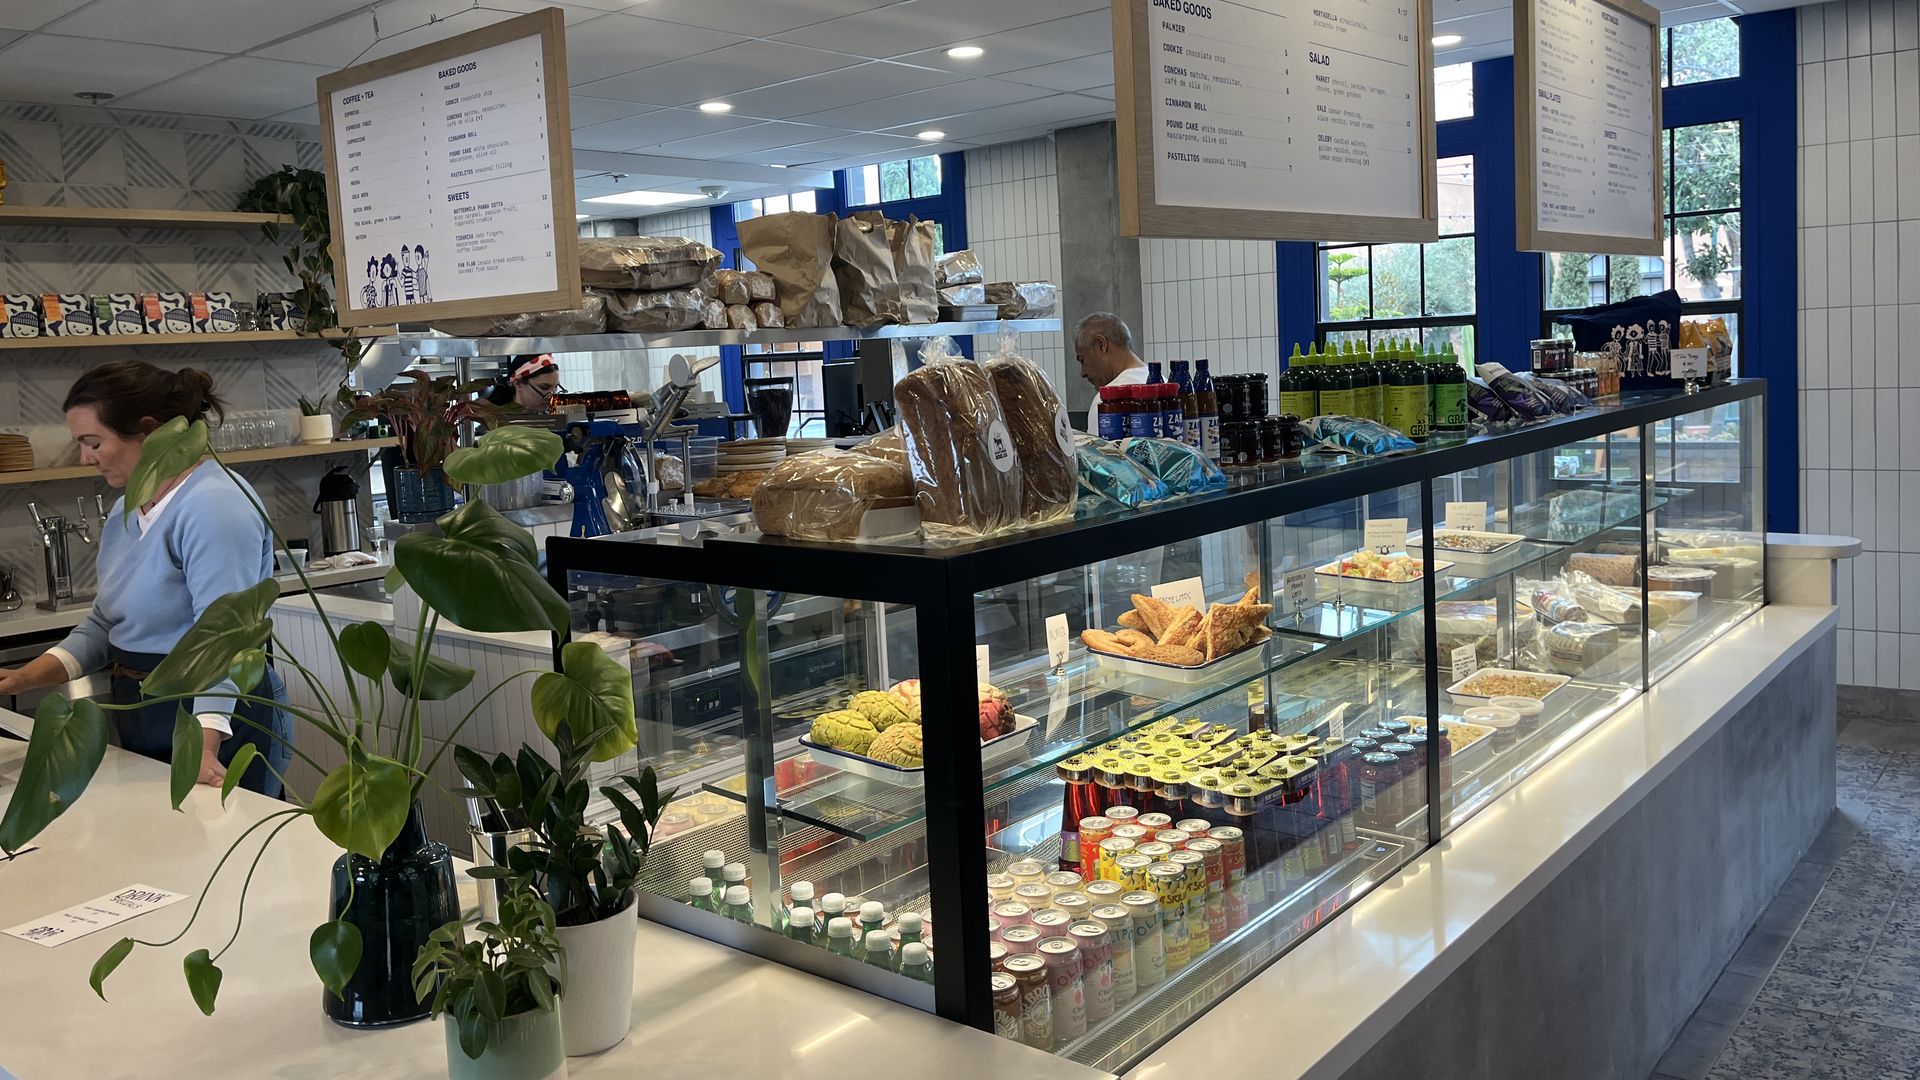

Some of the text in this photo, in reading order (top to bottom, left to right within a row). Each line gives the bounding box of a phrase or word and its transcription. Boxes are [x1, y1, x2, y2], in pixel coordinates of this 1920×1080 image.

[1182, 3, 1212, 20] GOODS
[1314, 9, 1338, 22] MORTADELLA
[1162, 21, 1186, 33] PALMIER
[1162, 43, 1184, 54] COOKIE
[1186, 50, 1212, 60] chocolate
[1214, 56, 1226, 64] chip
[1309, 52, 1330, 66] SALAD
[438, 62, 477, 79] BAKED GOODS
[1164, 65, 1188, 77] CONCHAS
[1190, 72, 1210, 82] matcha,
[1164, 78, 1177, 86] café
[1188, 82, 1200, 90] olla
[1204, 84, 1212, 92] (v)
[1316, 75, 1330, 84] MARKET
[343, 94, 361, 105] COFFEE
[364, 91, 374, 100] TEA
[1165, 98, 1192, 110] CINNAMON
[1194, 102, 1207, 111] ROLL
[1316, 104, 1327, 112] KALE
[1166, 120, 1182, 130] POUND
[1185, 122, 1198, 131] CAKE
[1201, 126, 1216, 134] white
[1218, 128, 1246, 137] chocolate,
[448, 134, 466, 142] CINNAMON
[1166, 132, 1200, 143] mascarpone,
[1202, 136, 1217, 144] olive
[1318, 134, 1332, 143] CELERY
[1168, 152, 1200, 163] PASTELITOS
[1202, 156, 1226, 166] seasonal
[1228, 159, 1246, 168] filling
[450, 169, 474, 178] PASTELITOS
[496, 162, 512, 170] filling
[448, 191, 470, 202] SWEETS
[454, 206, 476, 214] BUTTERMILK
[1153, 417, 1163, 427] ZA
[1448, 414, 1466, 424] GRA
[1160, 592, 1192, 604] ASTELITOS
